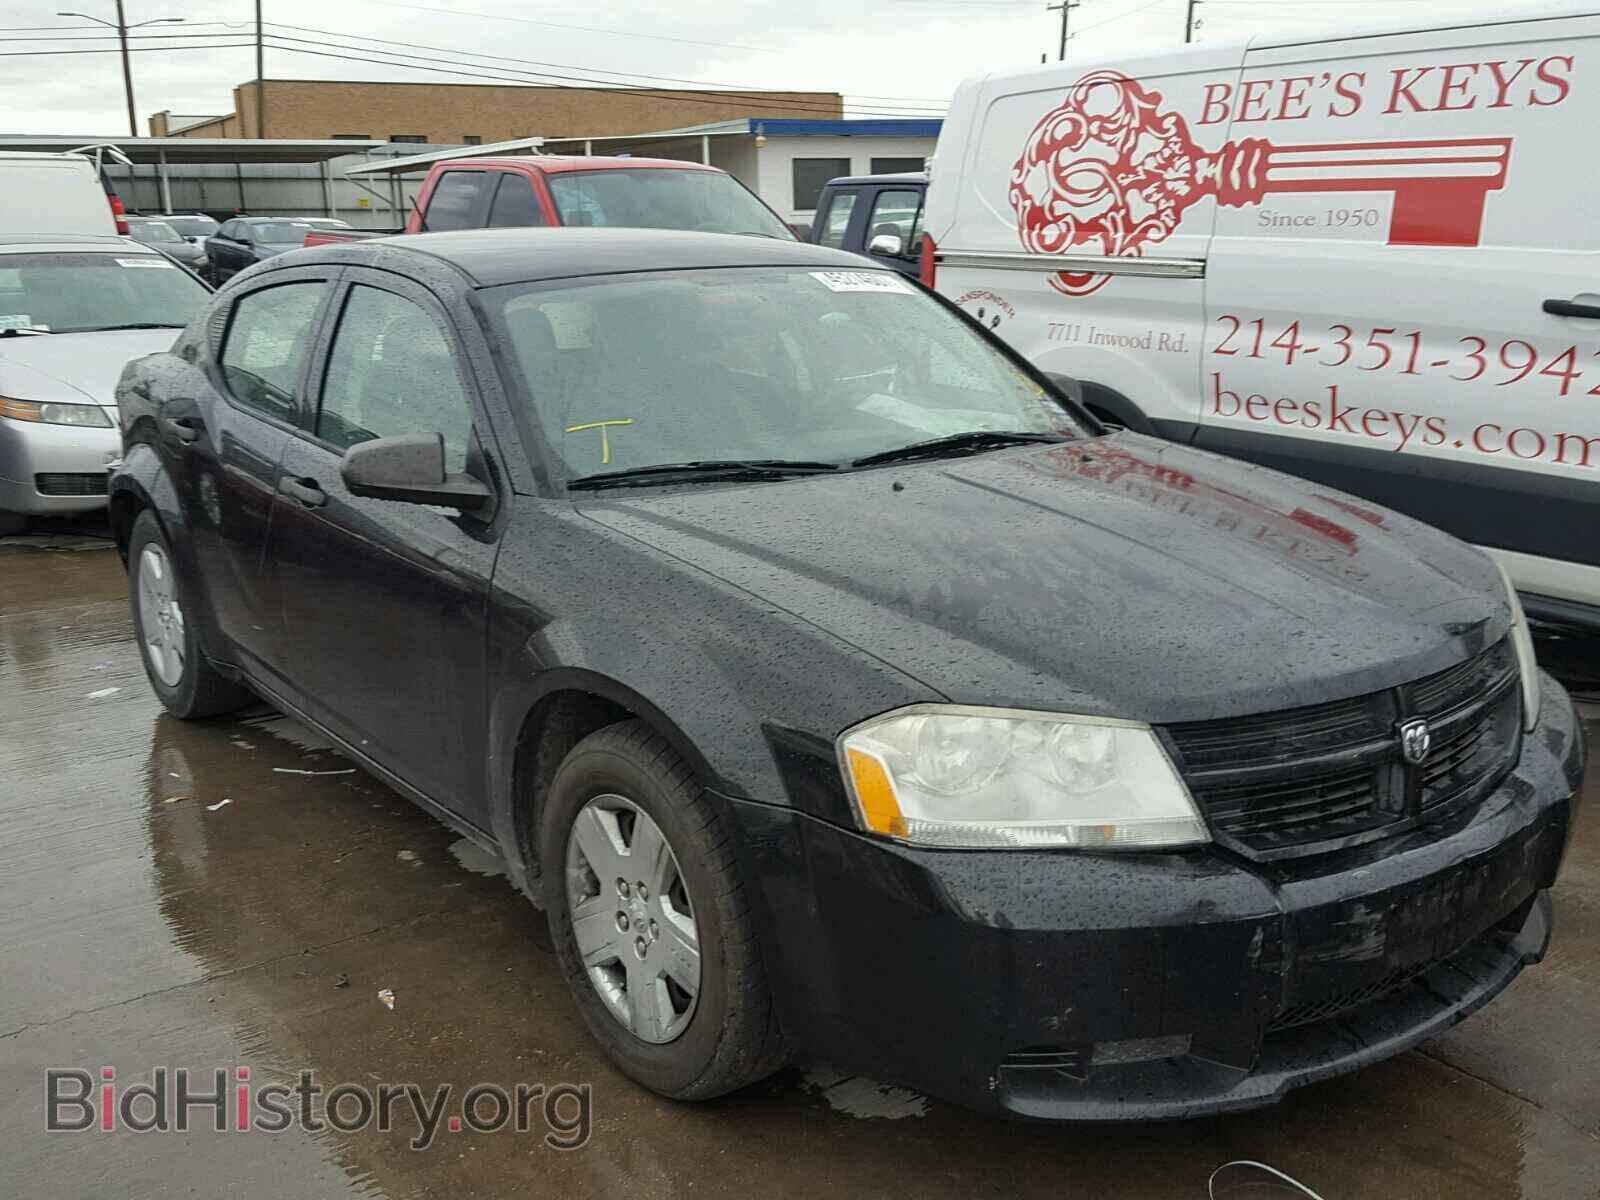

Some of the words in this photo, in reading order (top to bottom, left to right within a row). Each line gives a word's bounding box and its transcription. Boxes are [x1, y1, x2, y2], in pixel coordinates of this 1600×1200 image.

[1196, 70, 1364, 125] BEE'S
[1382, 55, 1575, 115] KEYS
[1256, 210, 1316, 229] Since
[1323, 207, 1380, 228] 1950
[1047, 322, 1081, 342] 7711
[1087, 325, 1151, 351] Inwood
[1157, 331, 1190, 353] Rd.
[565, 418, 634, 465] T
[1210, 372, 1600, 468] beeskeys.com
